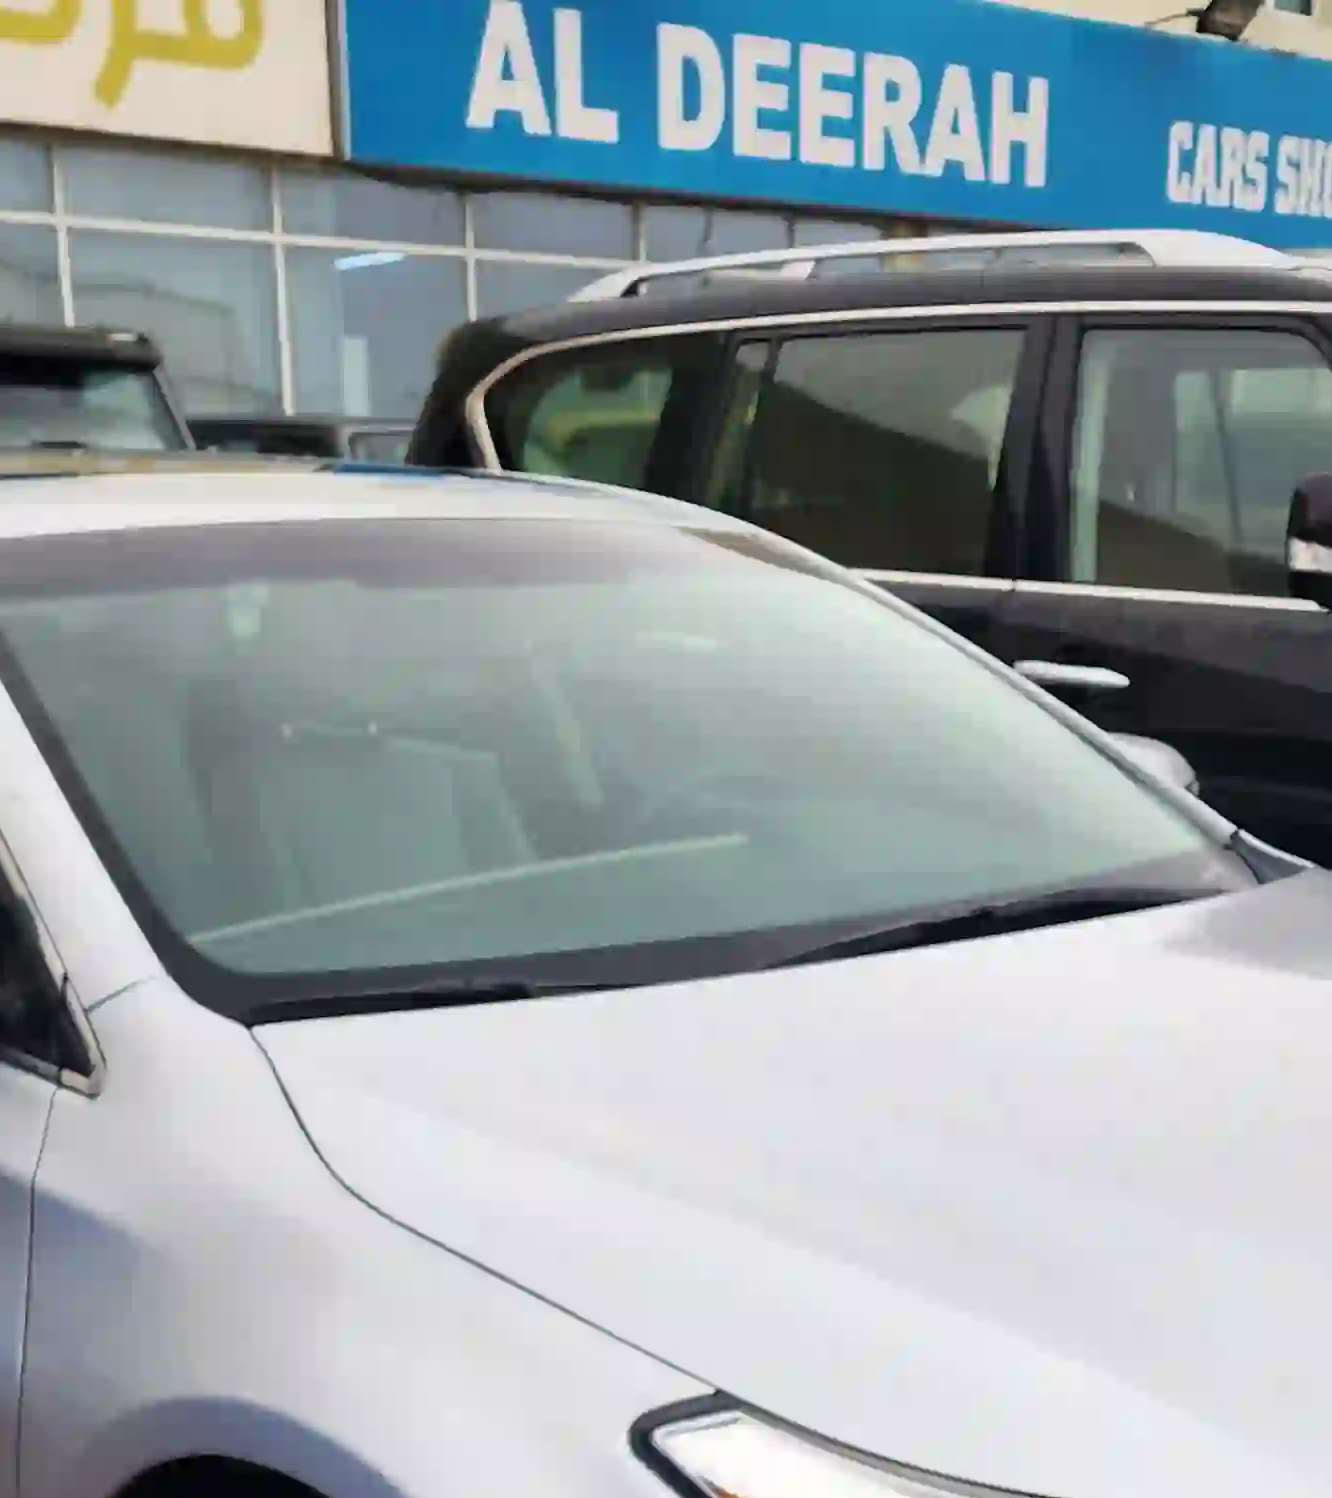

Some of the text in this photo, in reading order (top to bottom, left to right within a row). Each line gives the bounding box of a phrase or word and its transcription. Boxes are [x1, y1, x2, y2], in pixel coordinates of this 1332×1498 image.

[465, 0, 1050, 188] AL DEERAH
[1167, 121, 1269, 213] CARS
